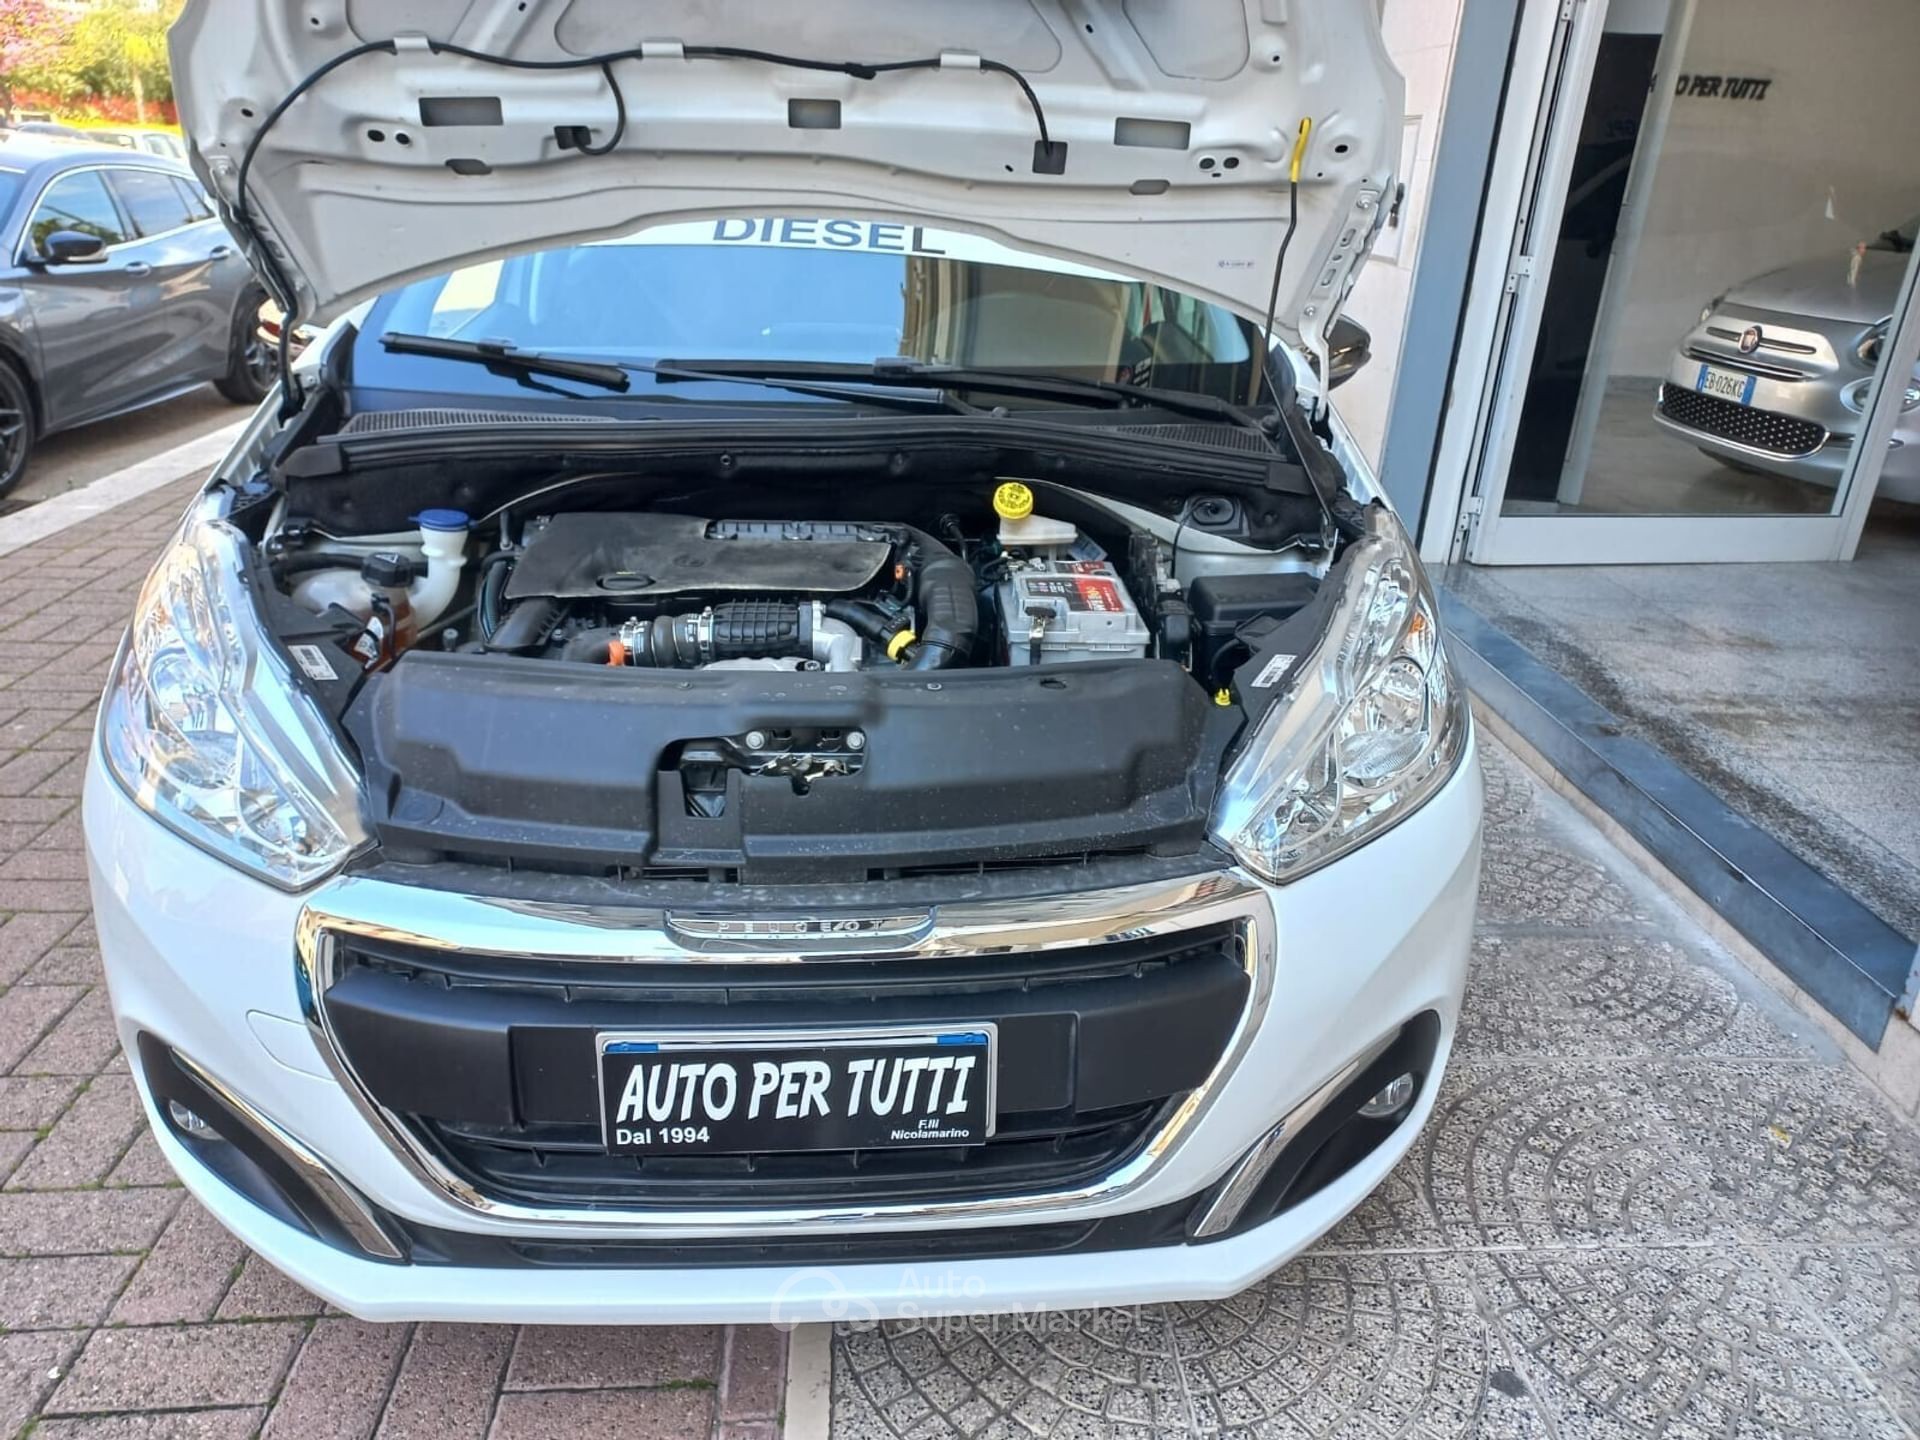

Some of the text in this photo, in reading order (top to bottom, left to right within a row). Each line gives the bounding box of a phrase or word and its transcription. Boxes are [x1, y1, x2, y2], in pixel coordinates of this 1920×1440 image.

[1688, 75, 1722, 97] PER
[1722, 77, 1772, 100] TUTTI
[713, 217, 946, 255] DIESEL
[616, 1055, 975, 1124] AUTO PER TUTTI
[616, 1126, 710, 1145] Dal 1994
[890, 1127, 970, 1141] Nicolamarino
